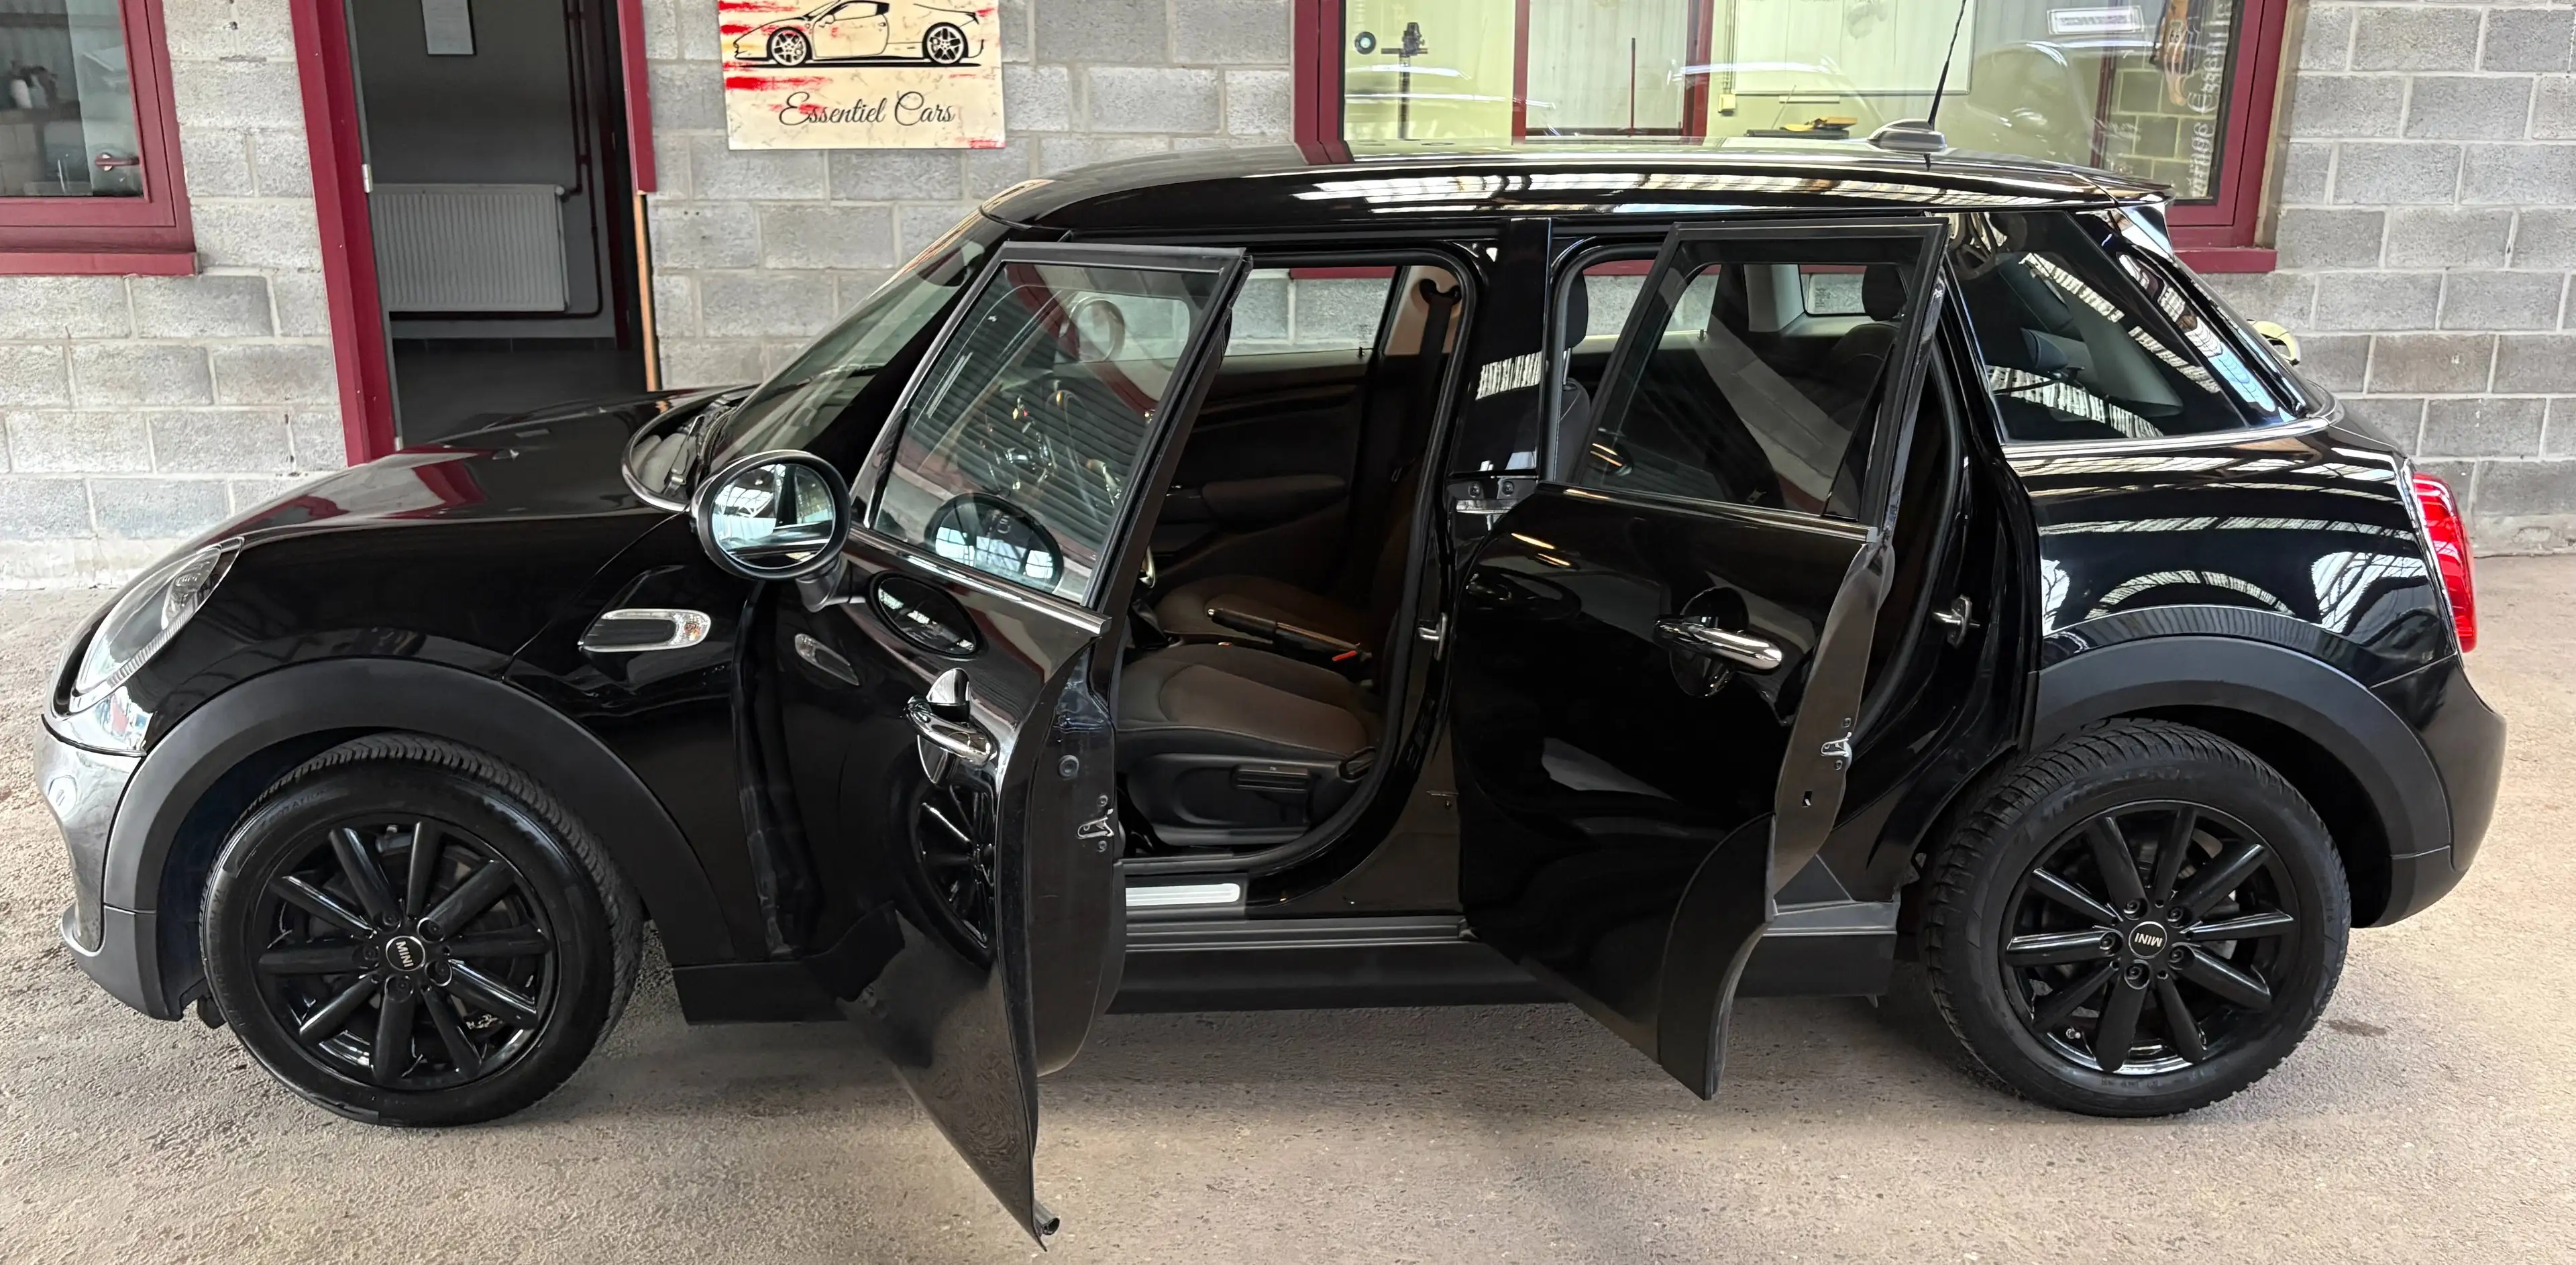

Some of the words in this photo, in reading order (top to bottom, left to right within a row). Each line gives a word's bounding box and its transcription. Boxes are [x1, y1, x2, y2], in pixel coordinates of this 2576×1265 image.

[779, 91, 887, 126] Essentiel
[894, 91, 955, 126] Cars
[2190, 122, 2214, 197] arage
[396, 940, 415, 968] MINI
[2134, 932, 2163, 948] MINI
